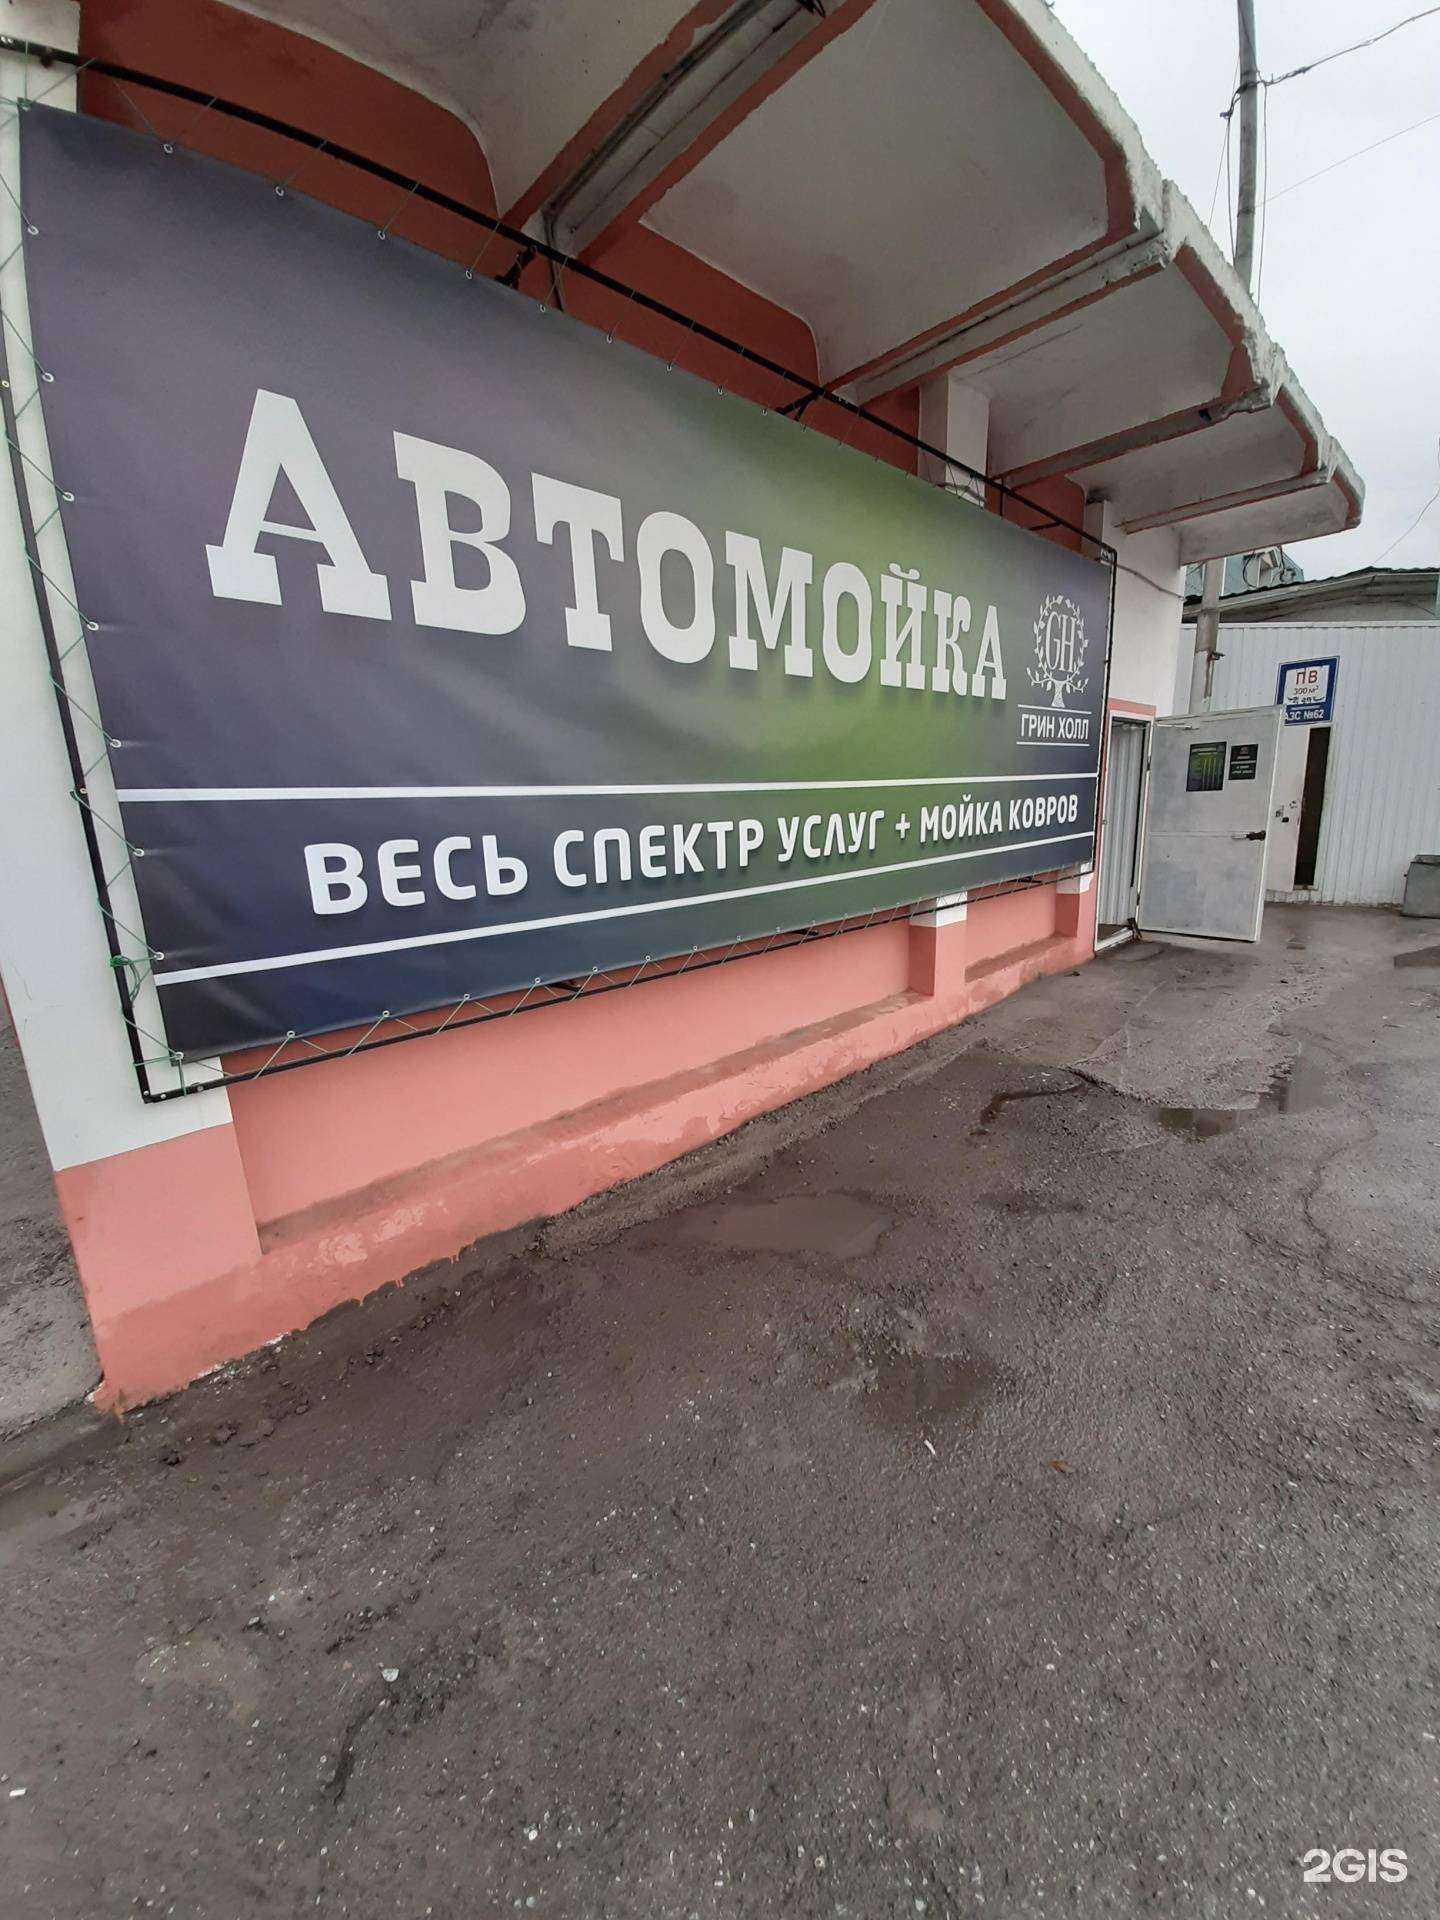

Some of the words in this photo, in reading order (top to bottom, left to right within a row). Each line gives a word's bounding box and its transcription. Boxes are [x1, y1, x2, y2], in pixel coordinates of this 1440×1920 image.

[205, 388, 1007, 701] АВТОМОЙКА
[1020, 713, 1055, 738] ГРИН
[1057, 716, 1090, 740] ХОЛЛ
[304, 834, 528, 915] ВЕСЬ
[553, 818, 765, 888] СПЕКТР
[777, 809, 885, 862] УСЛУГ
[895, 813, 910, 839] +
[919, 793, 1003, 843] МОЙКА
[1008, 794, 1078, 831] КОВРОВ
